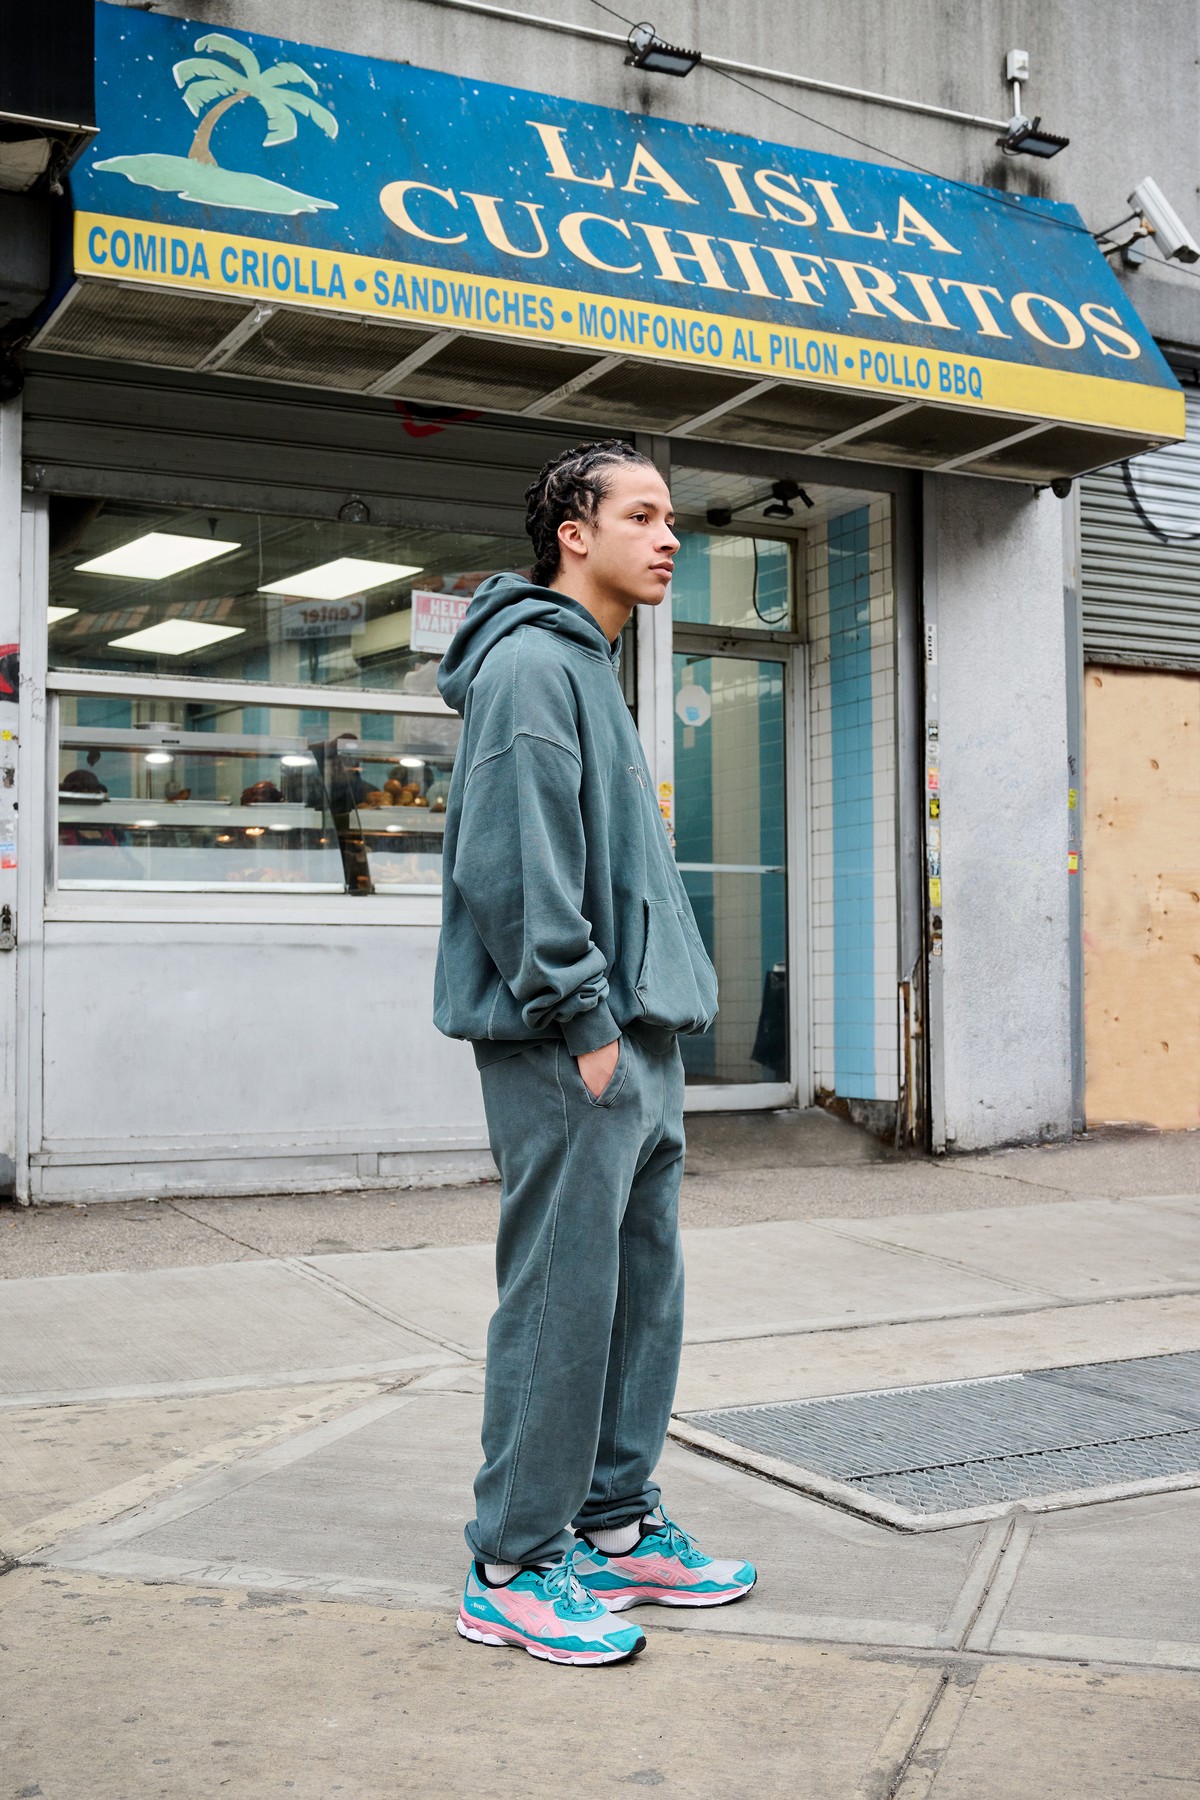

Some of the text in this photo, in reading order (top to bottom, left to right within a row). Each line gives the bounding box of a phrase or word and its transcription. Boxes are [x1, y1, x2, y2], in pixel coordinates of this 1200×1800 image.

[525, 120, 962, 256] LA ISLA
[88, 226, 984, 400] COMIDA CRIOLLA SANDWICHES MONFONGO AL PILON POLLO BBQ
[378, 180, 1142, 362] CUCHIFRITOS
[418, 614, 463, 634] WANT
[430, 598, 467, 619] HELP
